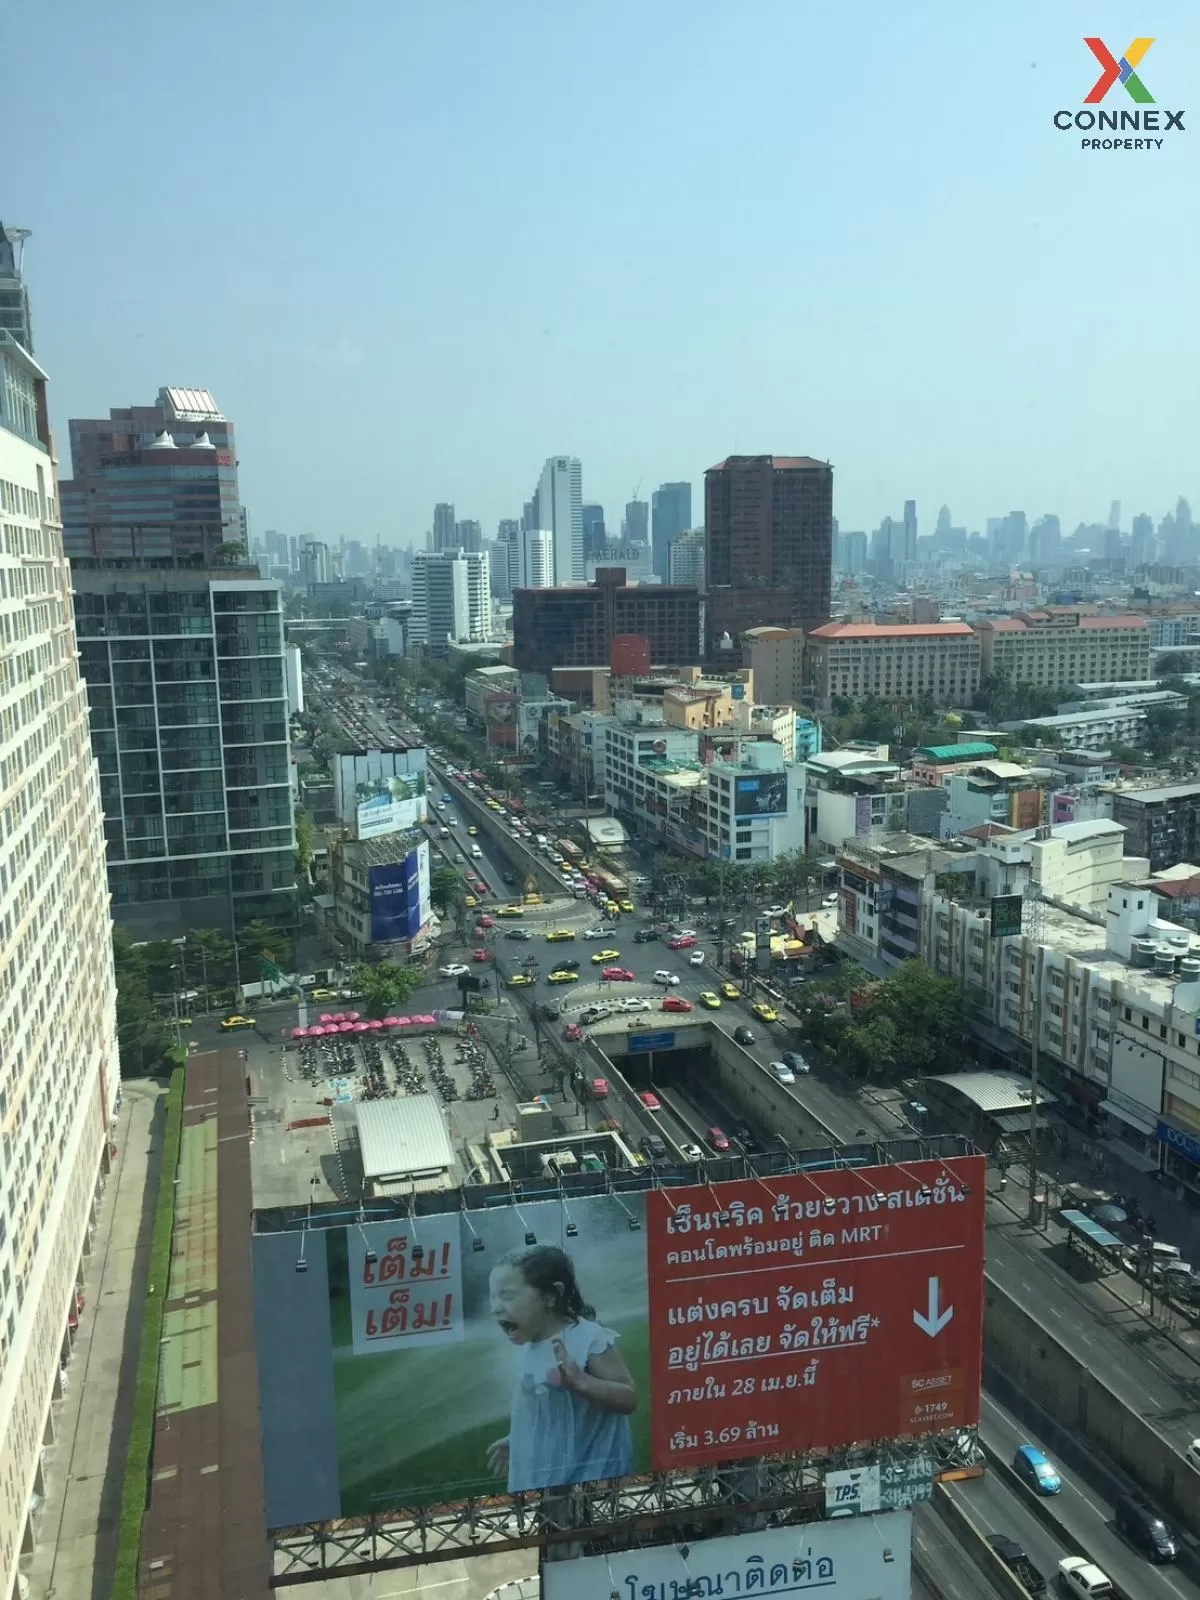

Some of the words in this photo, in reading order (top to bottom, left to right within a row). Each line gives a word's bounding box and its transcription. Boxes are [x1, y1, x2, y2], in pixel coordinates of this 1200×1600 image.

[364, 1235, 450, 1284] เต็ม!
[666, 1231, 803, 1265] คอนโดพร้อมอยู่
[809, 1228, 835, 1248] ติด
[841, 1224, 883, 1245] MRT
[366, 1288, 453, 1335] เต็ม!
[668, 1297, 769, 1325] แต่งครบ
[776, 1278, 854, 1311] จัดเต็ม
[668, 1330, 771, 1371] อยู่ได้เลย
[667, 1376, 726, 1404] ภายใน
[731, 1377, 755, 1397] 28
[760, 1358, 820, 1392] เม.ย.นี้
[925, 1401, 948, 1413] 1749
[669, 1426, 698, 1450] เริ่ม
[703, 1426, 742, 1445] 3.69
[745, 1419, 780, 1440] ล้าน
